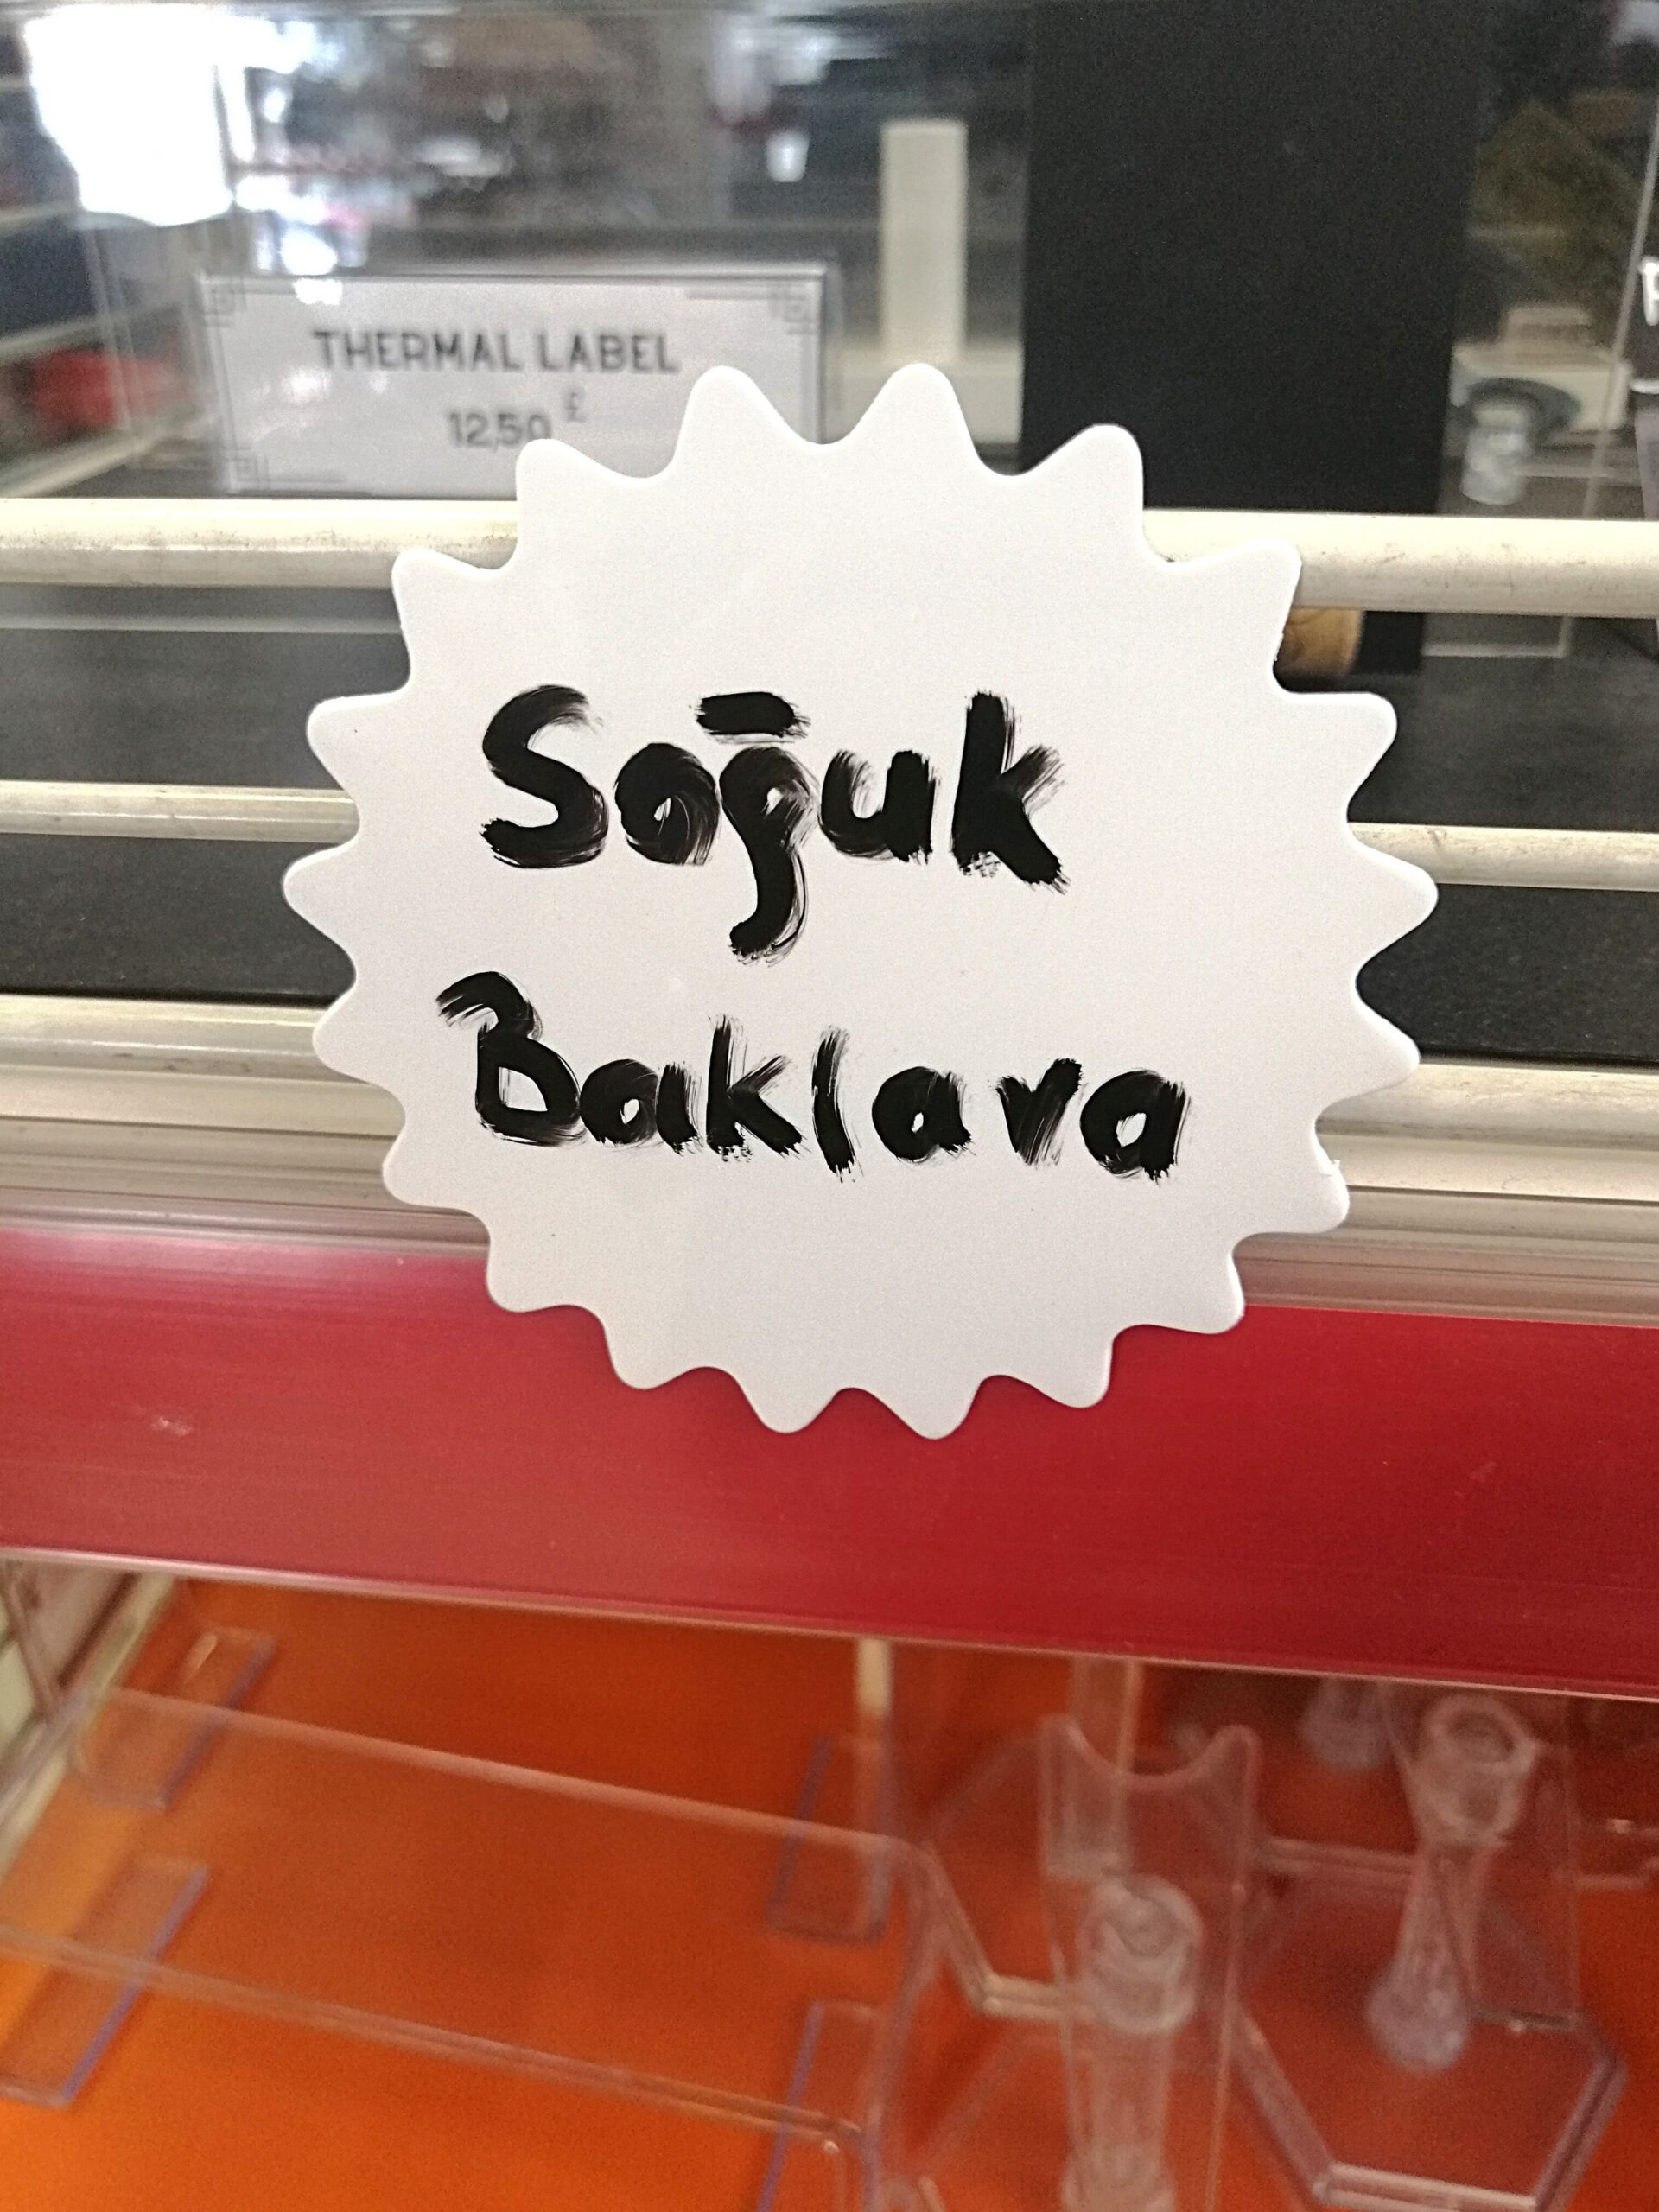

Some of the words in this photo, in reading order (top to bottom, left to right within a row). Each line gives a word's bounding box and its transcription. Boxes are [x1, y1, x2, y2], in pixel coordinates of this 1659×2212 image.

[313, 330, 525, 373] THERMAL
[535, 331, 681, 374] LABEL
[436, 971, 1192, 1184] Baklava
